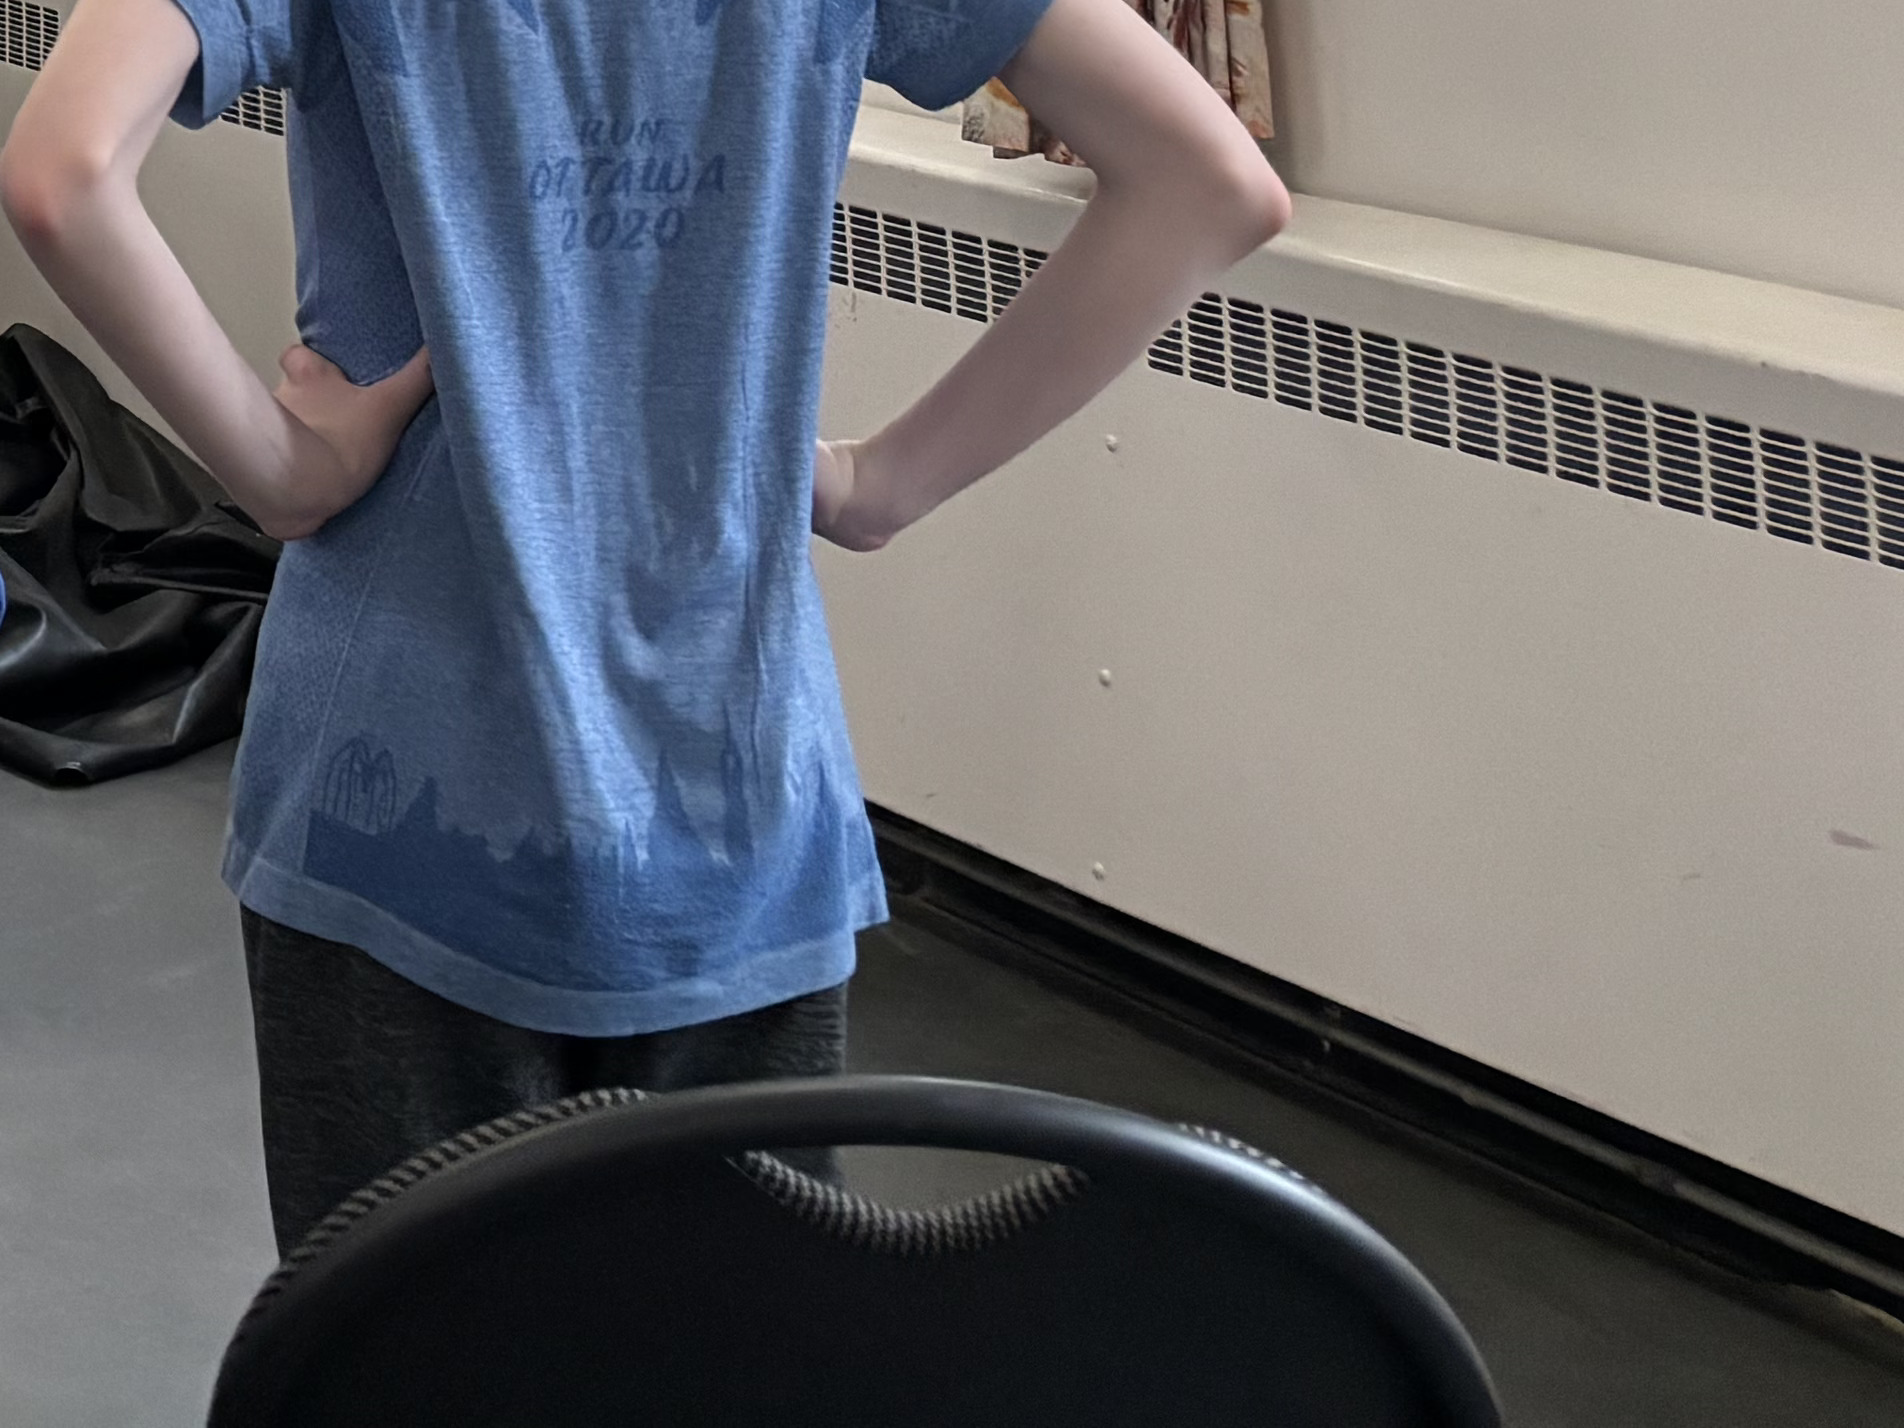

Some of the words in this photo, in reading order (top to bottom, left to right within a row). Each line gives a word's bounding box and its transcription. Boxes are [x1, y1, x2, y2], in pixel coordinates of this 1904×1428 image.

[579, 118, 665, 146] RUN
[530, 153, 726, 198] OTTAWA
[561, 206, 686, 251] 2020
